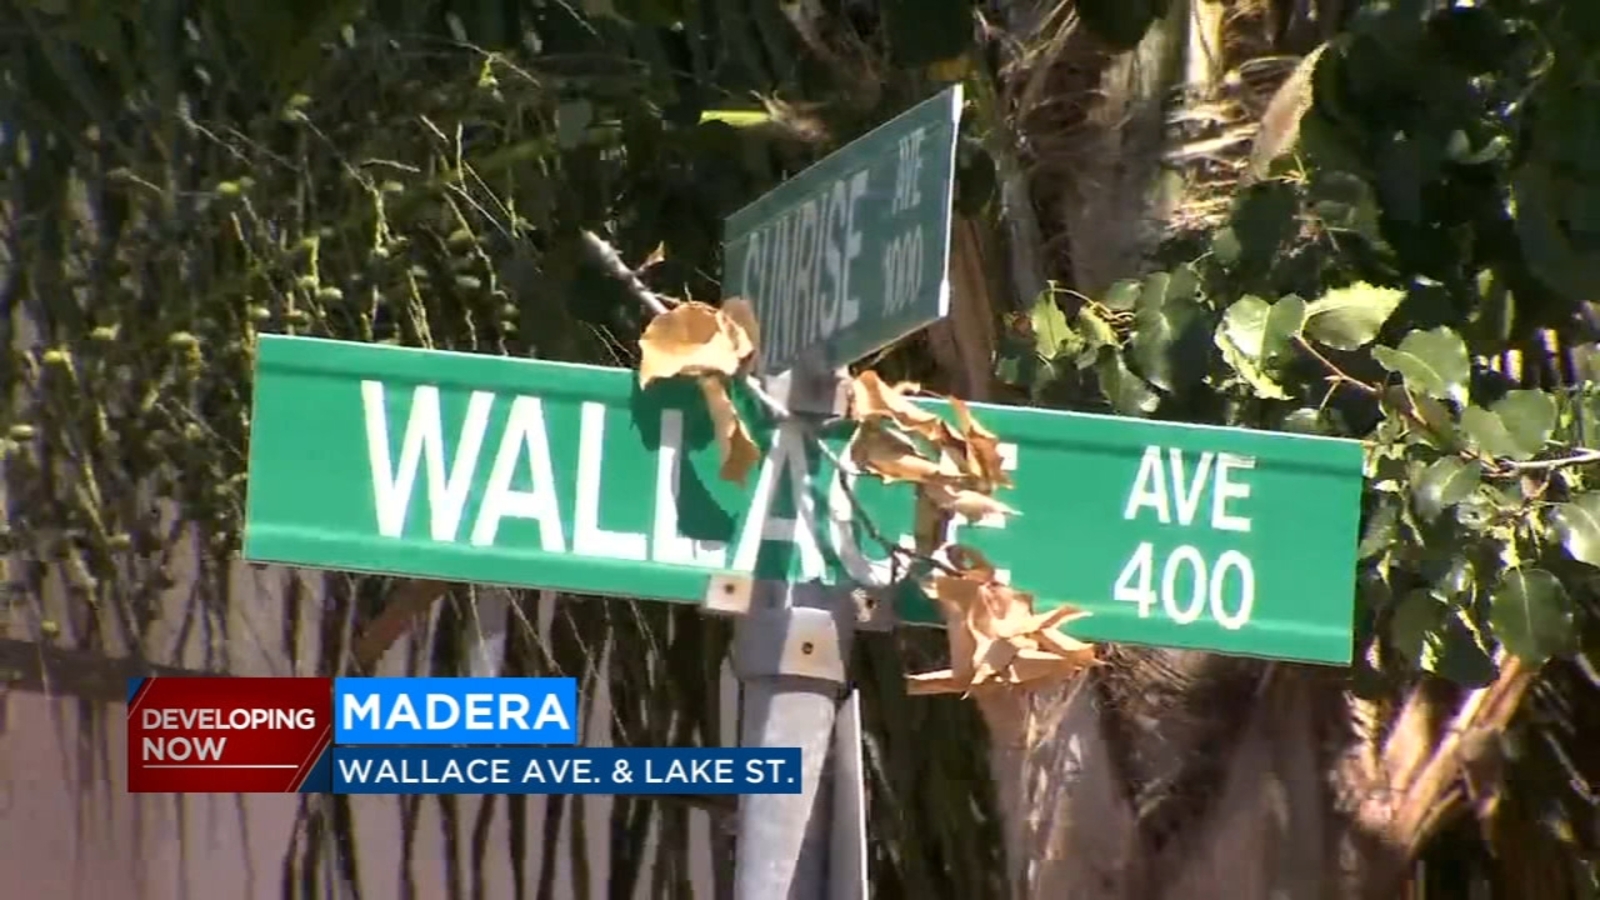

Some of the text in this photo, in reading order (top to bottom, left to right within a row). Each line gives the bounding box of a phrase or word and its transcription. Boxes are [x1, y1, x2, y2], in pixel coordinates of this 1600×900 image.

[891, 126, 926, 215] AVE
[1123, 445, 1257, 532] AVE
[1113, 541, 1256, 630] 400
